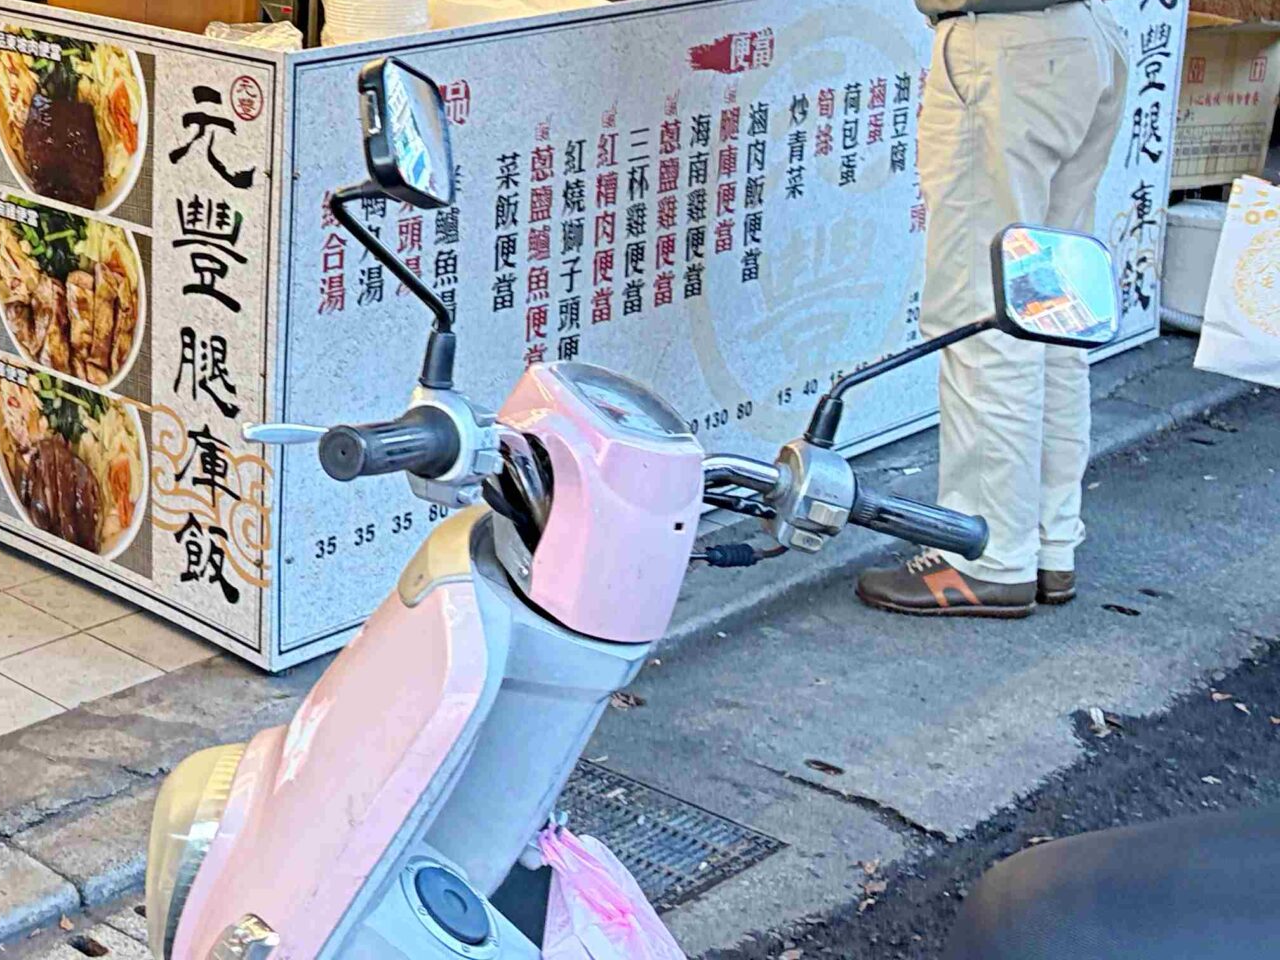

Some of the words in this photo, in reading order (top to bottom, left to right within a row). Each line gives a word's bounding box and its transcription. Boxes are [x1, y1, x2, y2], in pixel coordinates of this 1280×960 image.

[730, 28, 773, 72] 便當
[785, 93, 810, 200] 炒青菜
[839, 82, 863, 187] 荷包蛋
[866, 77, 888, 146] 滷蛋
[492, 151, 520, 313] 菜飯便當
[591, 133, 619, 325] 紅糟肉便當
[623, 127, 650, 316] 三杯雞便當
[684, 114, 712, 299] 海南雞便當
[742, 101, 769, 283] 滷肉飯便當
[169, 85, 255, 604] 元豐腿庫飯
[777, 388, 792, 405] 15
[803, 379, 818, 397] 40
[704, 409, 729, 431] 130
[736, 401, 753, 421] 80
[315, 536, 337, 559] 35
[354, 524, 376, 547] 35
[391, 511, 413, 534] 35
